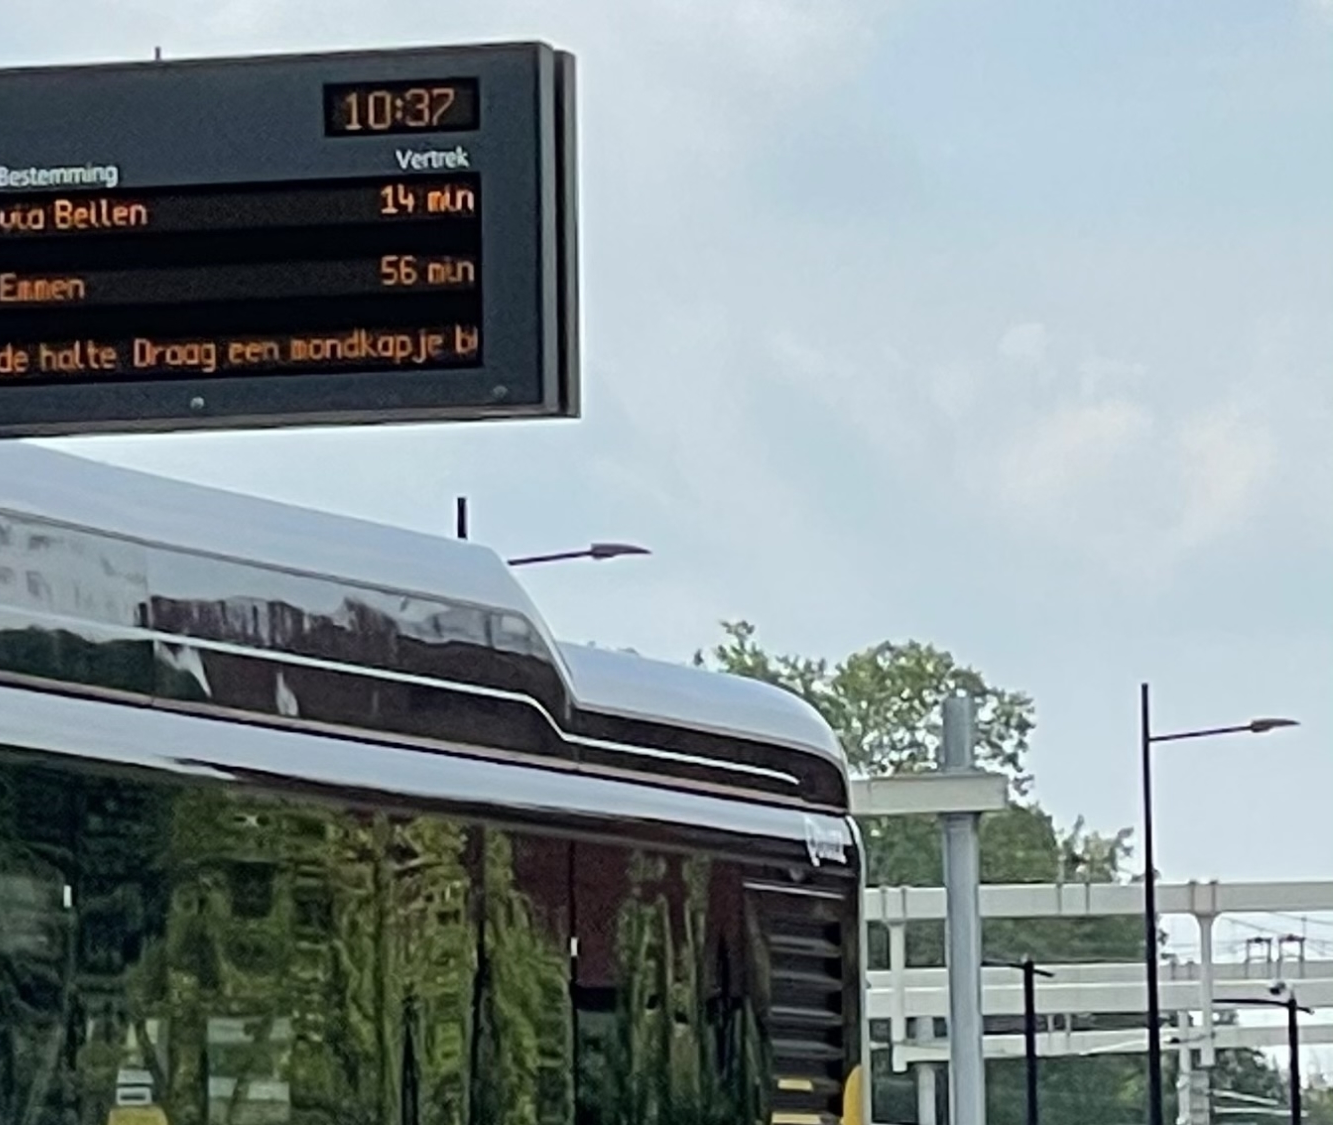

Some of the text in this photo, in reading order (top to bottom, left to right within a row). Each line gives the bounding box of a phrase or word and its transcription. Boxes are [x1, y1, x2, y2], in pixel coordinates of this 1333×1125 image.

[345, 87, 455, 131] 10:37
[395, 146, 470, 171] Vertrek
[54, 198, 149, 229] Bellen
[381, 183, 415, 214] 14
[427, 183, 475, 212] min
[381, 254, 418, 286] 56
[427, 256, 475, 284] min
[40, 339, 116, 372] halte
[134, 337, 216, 373] Draag
[228, 341, 279, 364] een
[290, 327, 443, 365] mondkapje
